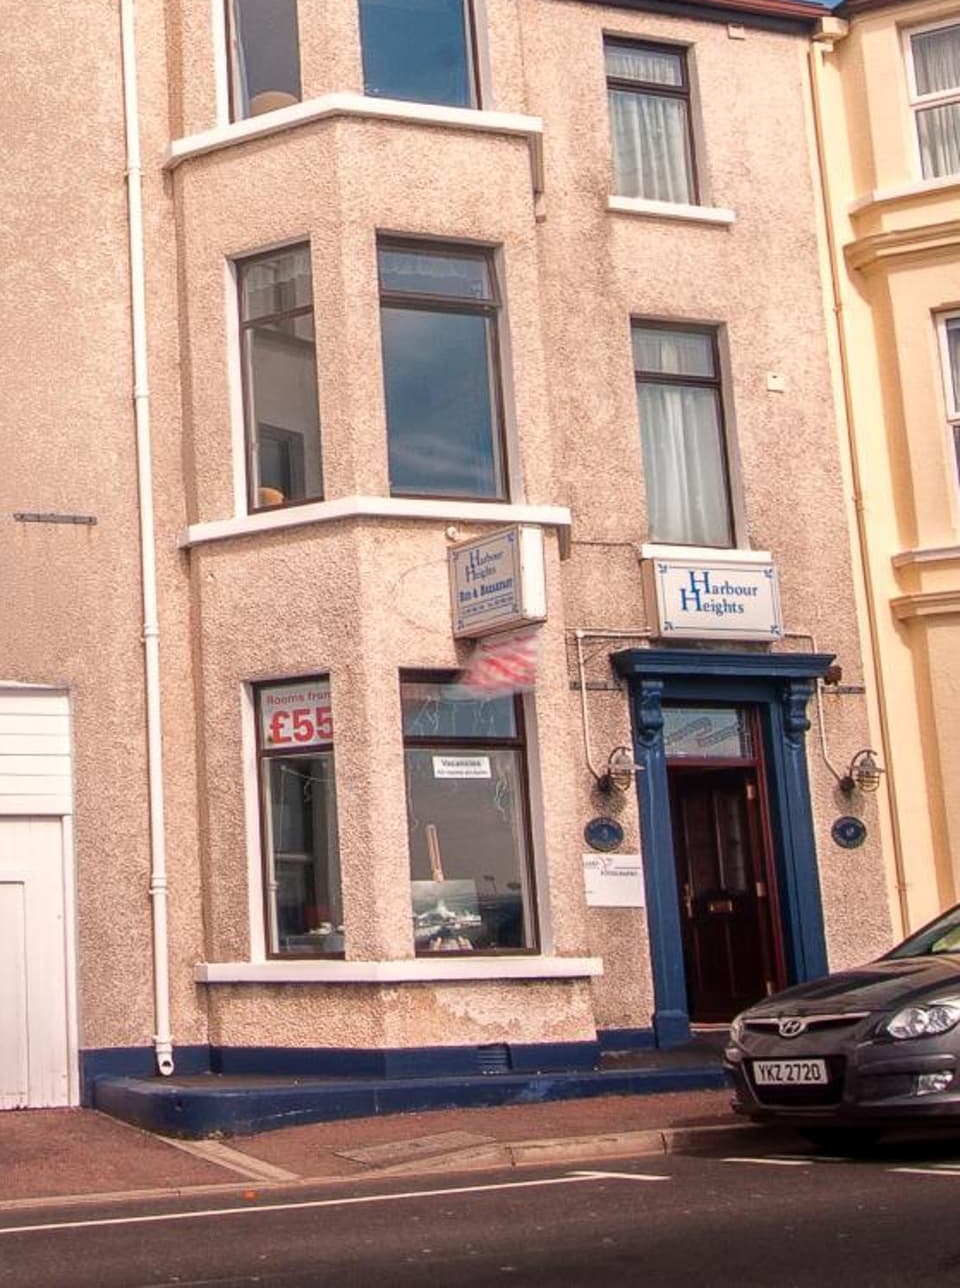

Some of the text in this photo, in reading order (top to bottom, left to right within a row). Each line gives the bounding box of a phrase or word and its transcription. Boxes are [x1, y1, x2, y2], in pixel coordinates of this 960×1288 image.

[688, 571, 758, 597] Harbour
[681, 588, 745, 616] Heights
[267, 694, 305, 705] Rooms
[269, 706, 334, 744] £55
[758, 1062, 821, 1082] YKZ 2720
